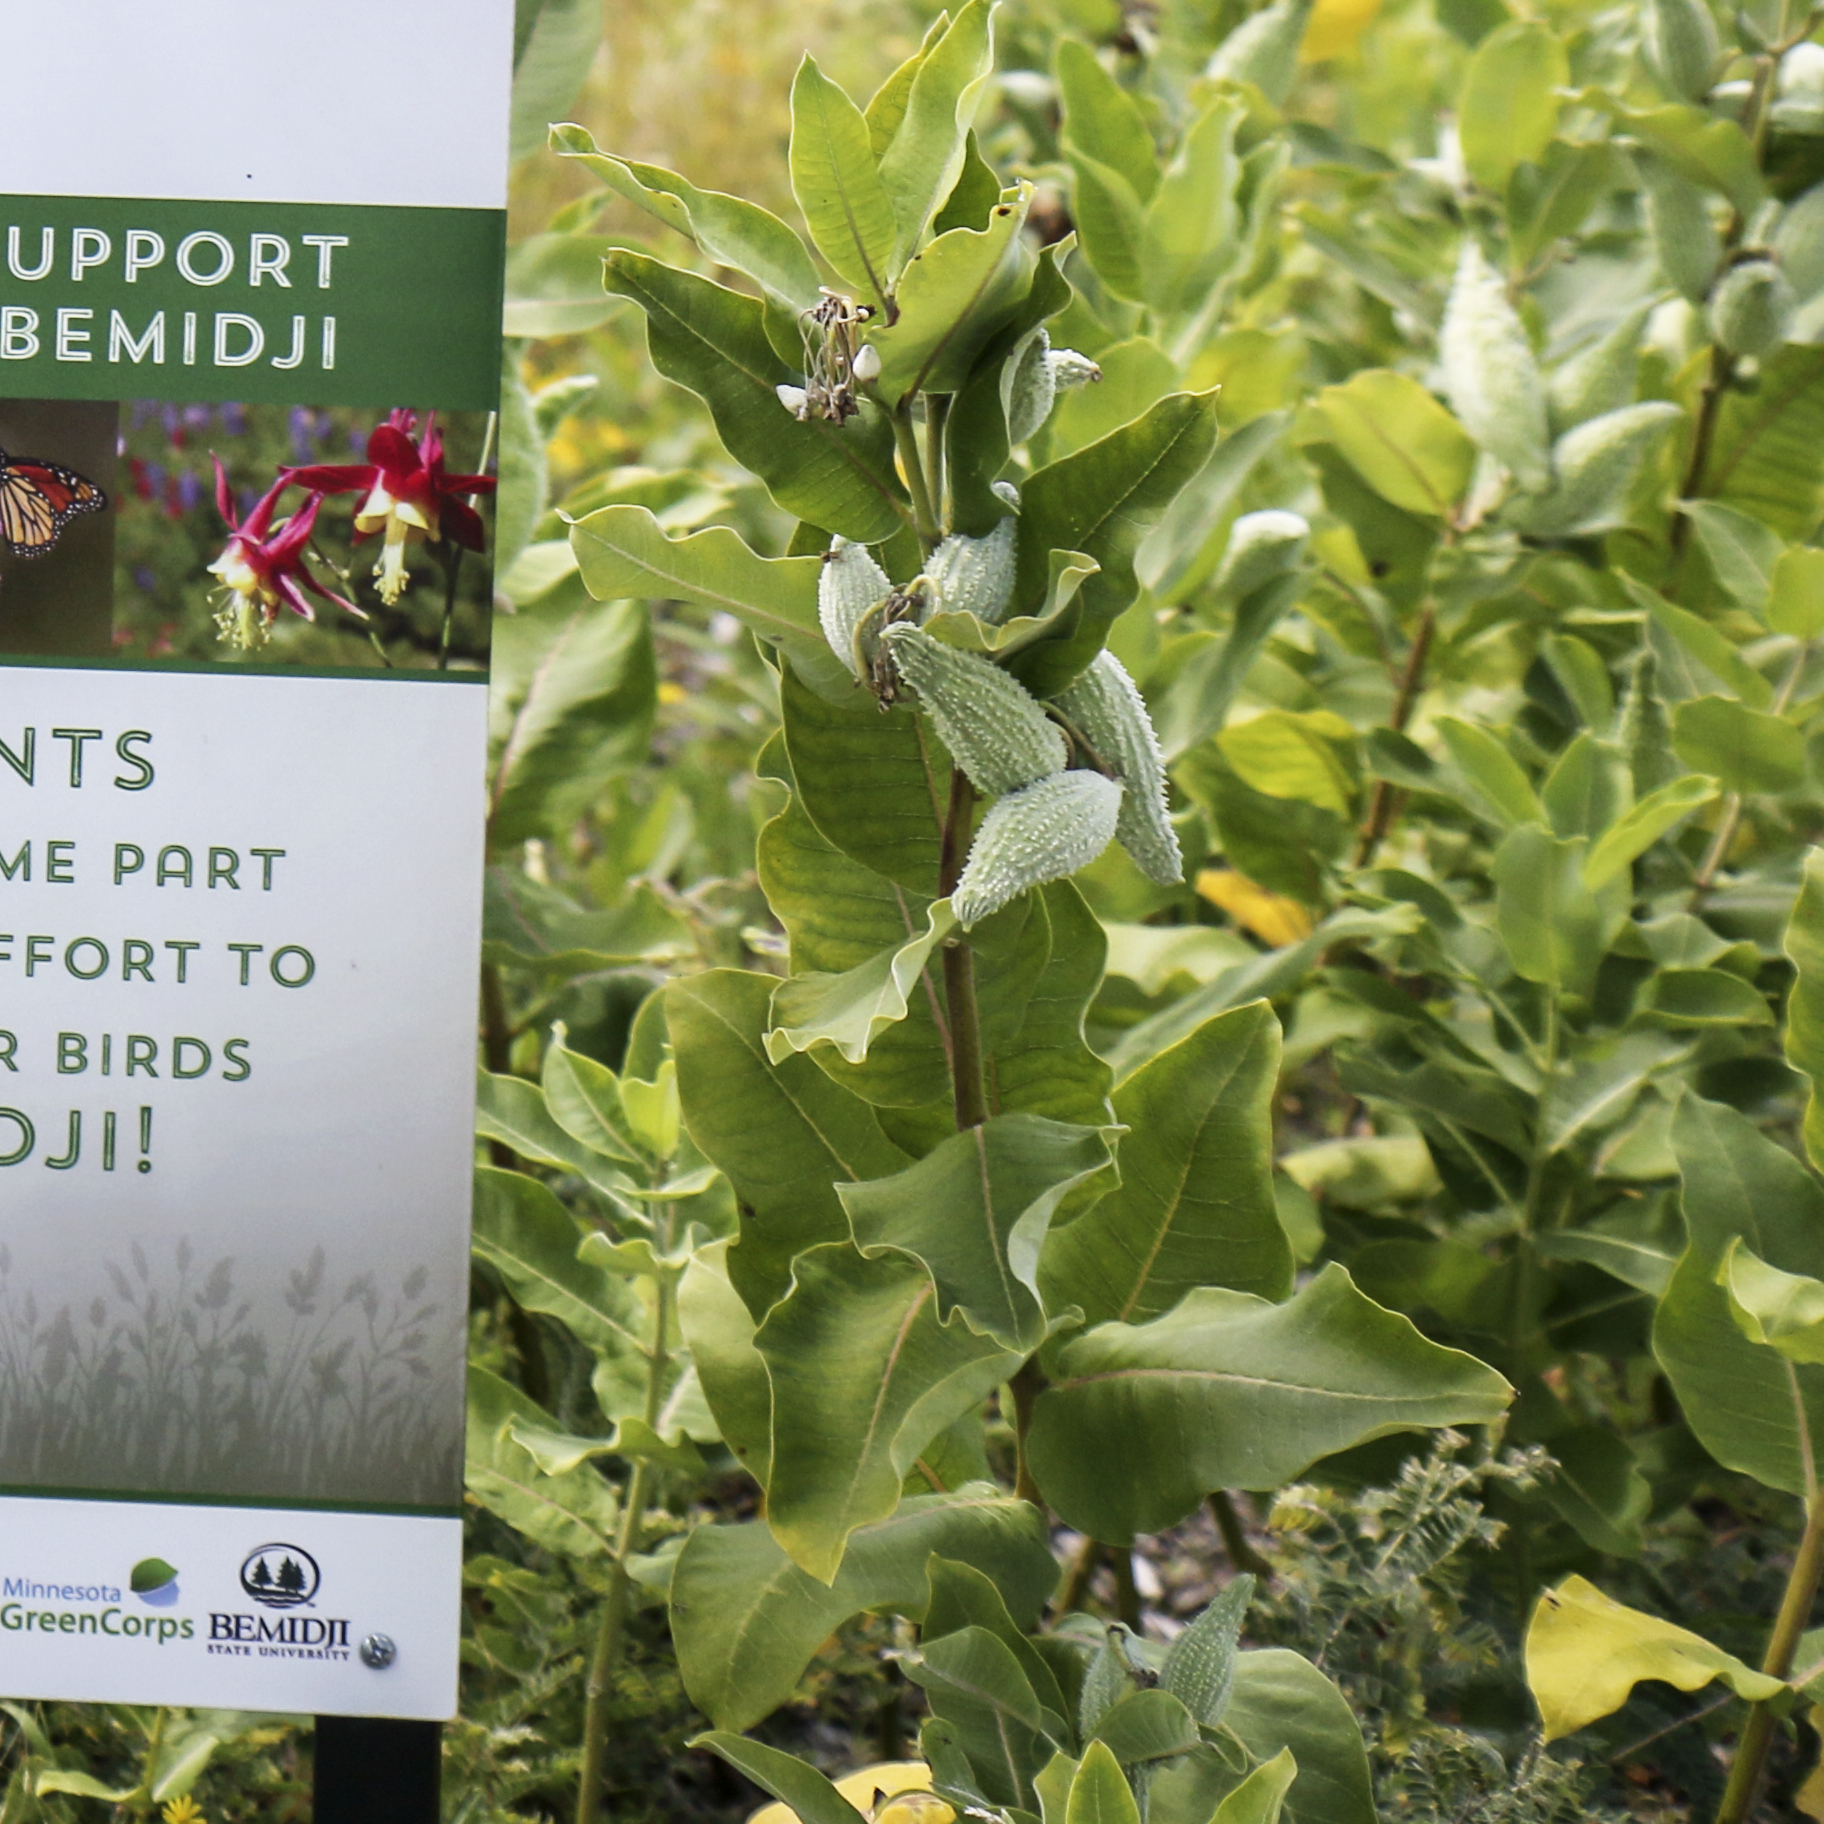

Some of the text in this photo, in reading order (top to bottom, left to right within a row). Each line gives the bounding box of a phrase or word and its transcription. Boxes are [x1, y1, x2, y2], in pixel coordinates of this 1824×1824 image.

[0, 306, 337, 370] BEMIDJI
[113, 843, 286, 891] PART
[228, 942, 316, 988] TO
[57, 1032, 252, 1083] BIRDS
[3, 1577, 121, 1602] Minnesota
[0, 1602, 194, 1645] GreenCorps
[208, 1613, 350, 1648] BEMIDJI
[207, 1643, 350, 1661] STATE UNIVERSITY
